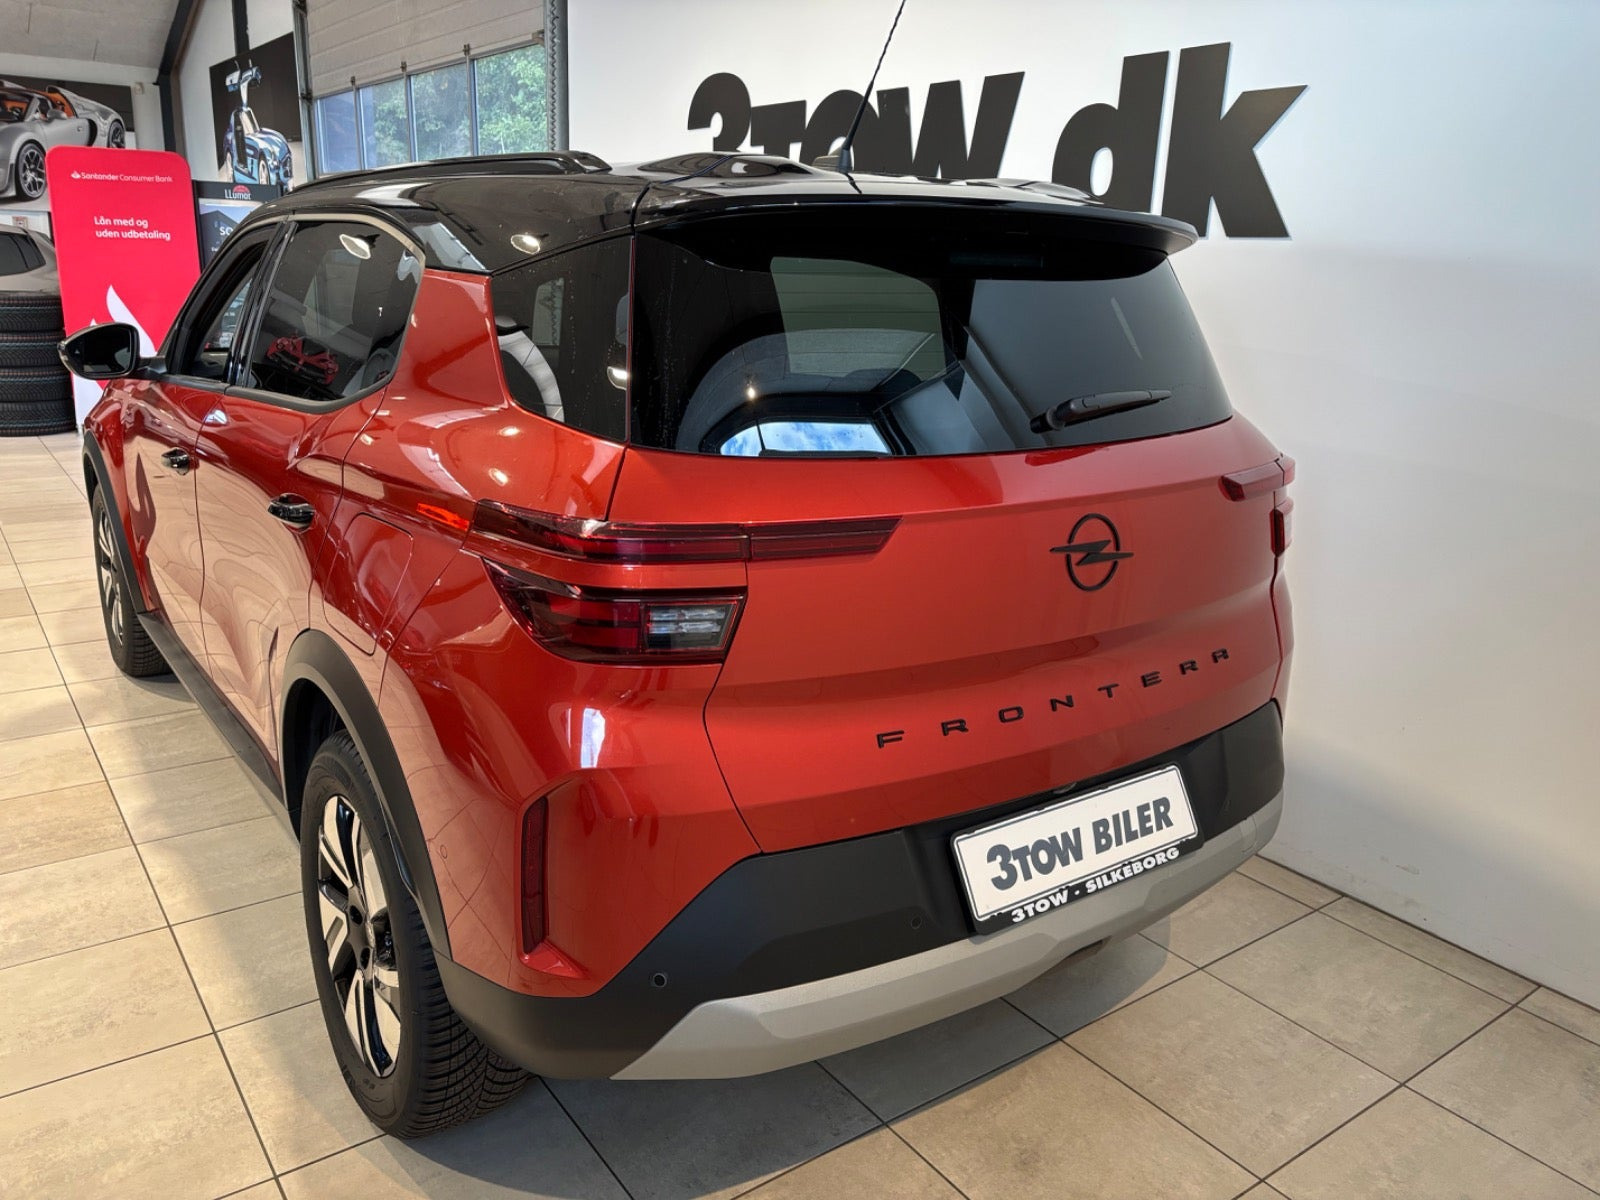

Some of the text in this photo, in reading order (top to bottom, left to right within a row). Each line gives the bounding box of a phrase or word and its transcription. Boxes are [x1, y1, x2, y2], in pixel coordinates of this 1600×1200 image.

[81, 171, 119, 181] Santander
[119, 174, 155, 182] Consumer
[94, 215, 149, 228] Lån med og
[95, 229, 171, 241] uden udbetaling
[876, 648, 1230, 749] FRONTERA
[986, 796, 1174, 892] 3TOW BILER
[1011, 847, 1180, 924] 3TOW SILKEBORG
